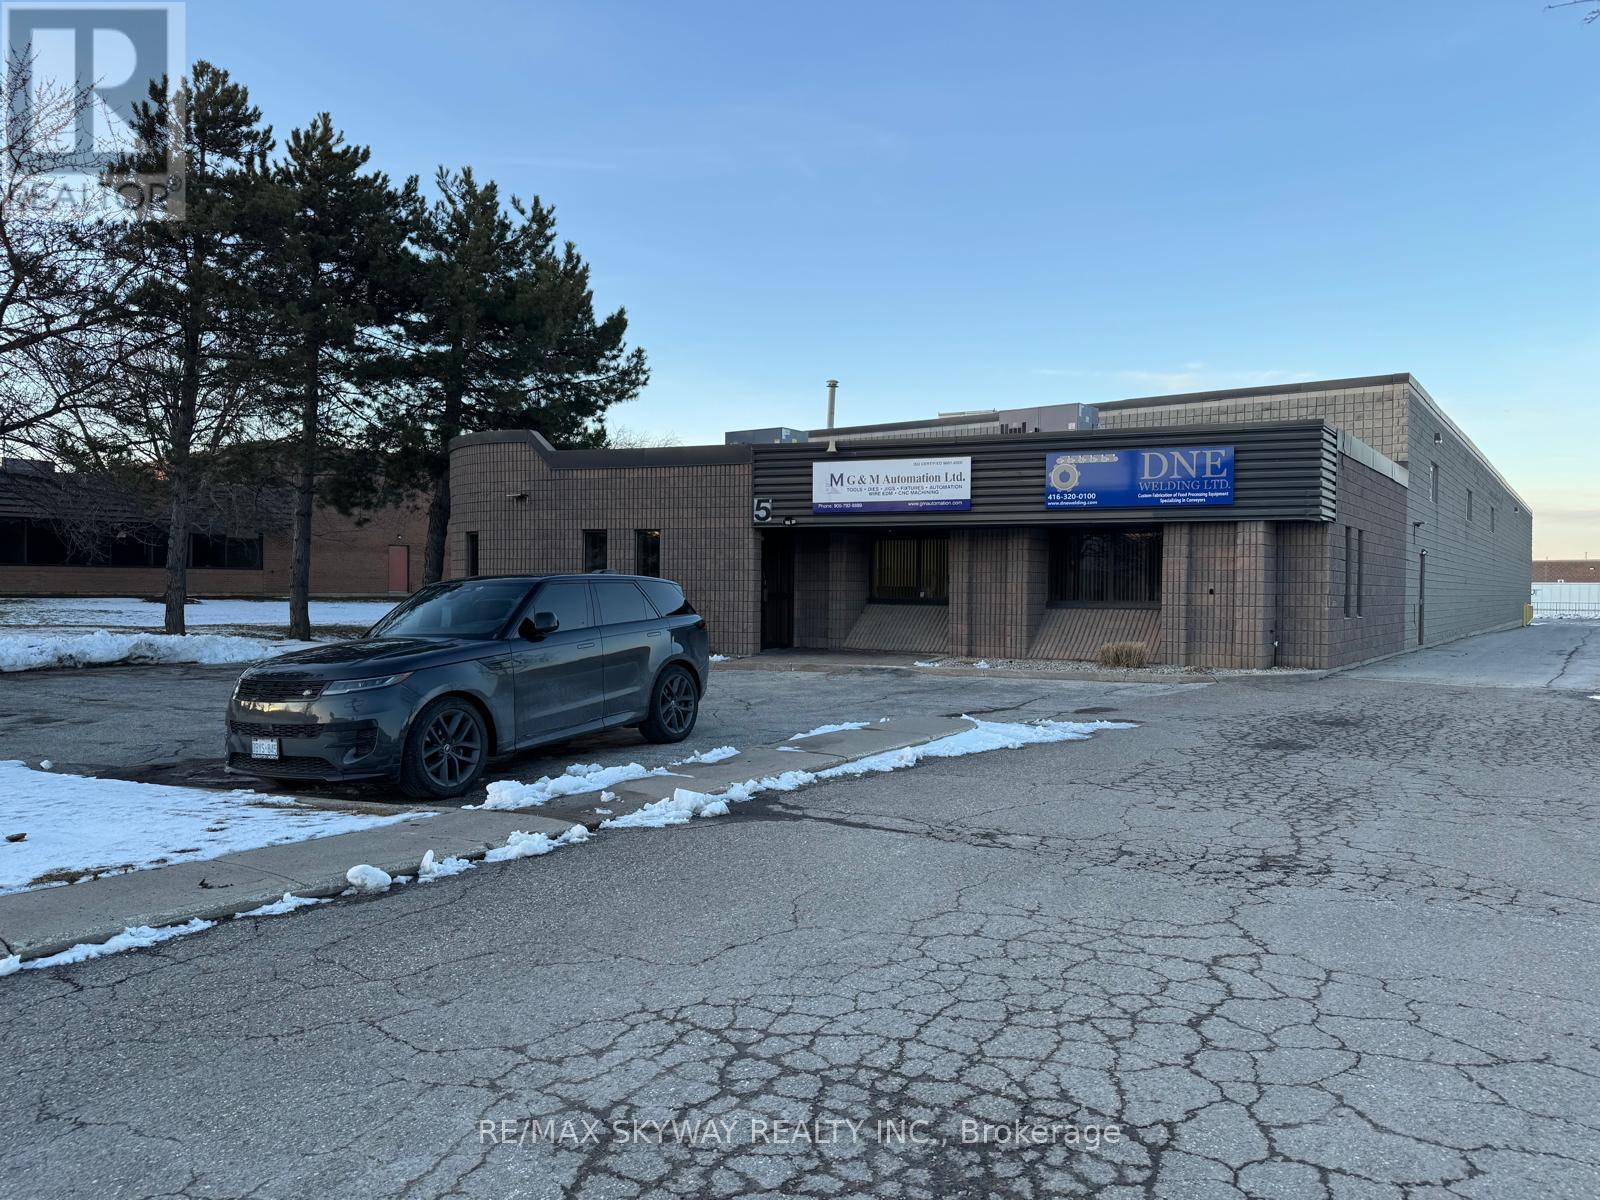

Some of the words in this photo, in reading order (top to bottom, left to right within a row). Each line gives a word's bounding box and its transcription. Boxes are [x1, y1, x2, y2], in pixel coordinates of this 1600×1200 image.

[1140, 449, 1227, 479] DNE
[830, 473, 844, 487] M
[847, 475, 856, 485] G
[858, 475, 867, 485] &
[869, 474, 880, 484] M
[883, 473, 941, 484] Automation
[945, 472, 966, 482] Ltd.
[1138, 480, 1200, 491] WELDING
[1203, 479, 1231, 490] LTD.
[754, 498, 771, 521] 5
